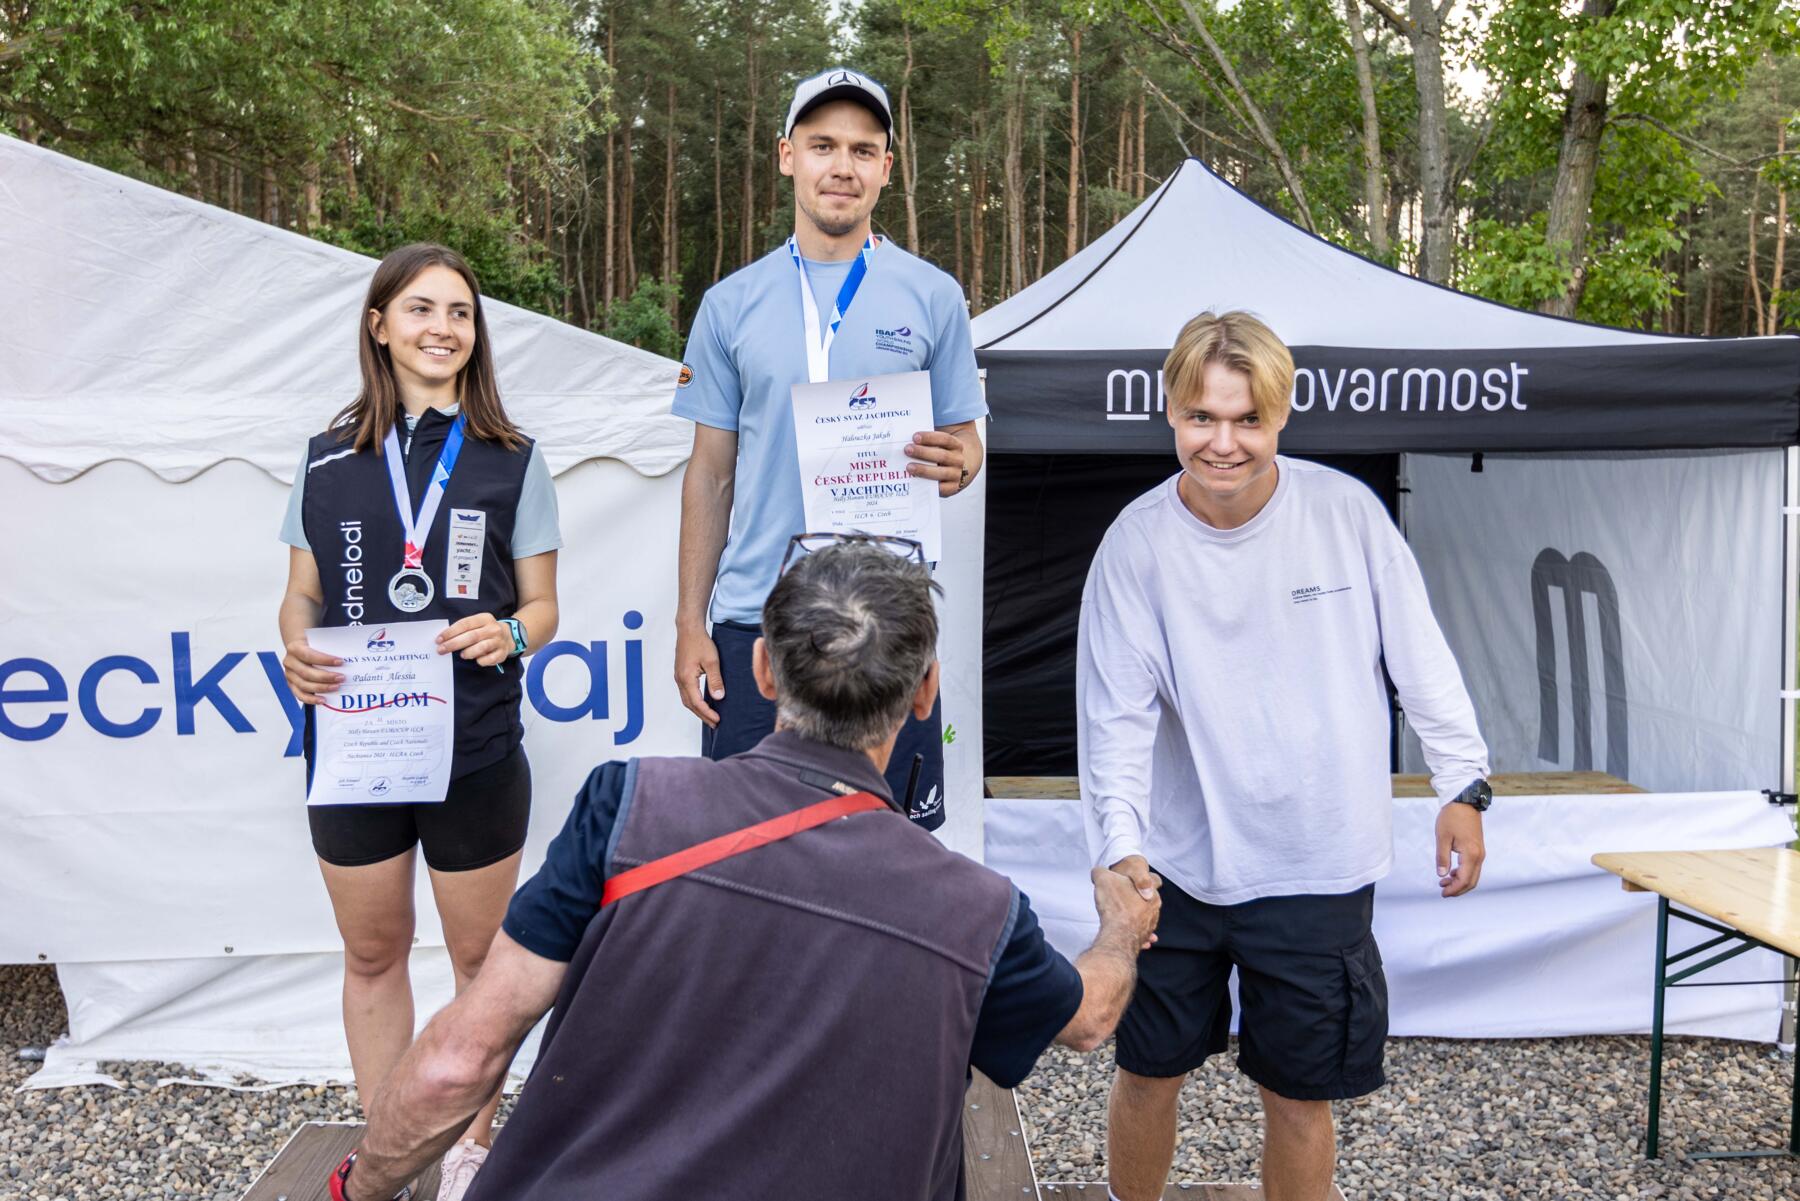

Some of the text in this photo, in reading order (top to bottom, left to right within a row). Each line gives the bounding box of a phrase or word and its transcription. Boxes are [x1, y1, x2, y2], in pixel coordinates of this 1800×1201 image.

[843, 413, 863, 422] SVAZ
[866, 409, 912, 420] JACHTINGU
[857, 450, 879, 458] TITUL
[849, 459, 887, 471] MISTR
[814, 472, 853, 487] ČESKÉ
[830, 483, 910, 497] V JACHTINGU
[1291, 585, 1321, 597] DREAMS
[384, 653, 431, 662] JACHTINGU
[386, 672, 416, 682] Alessia
[526, 610, 645, 745] aj
[341, 691, 429, 710] DIPLOM
